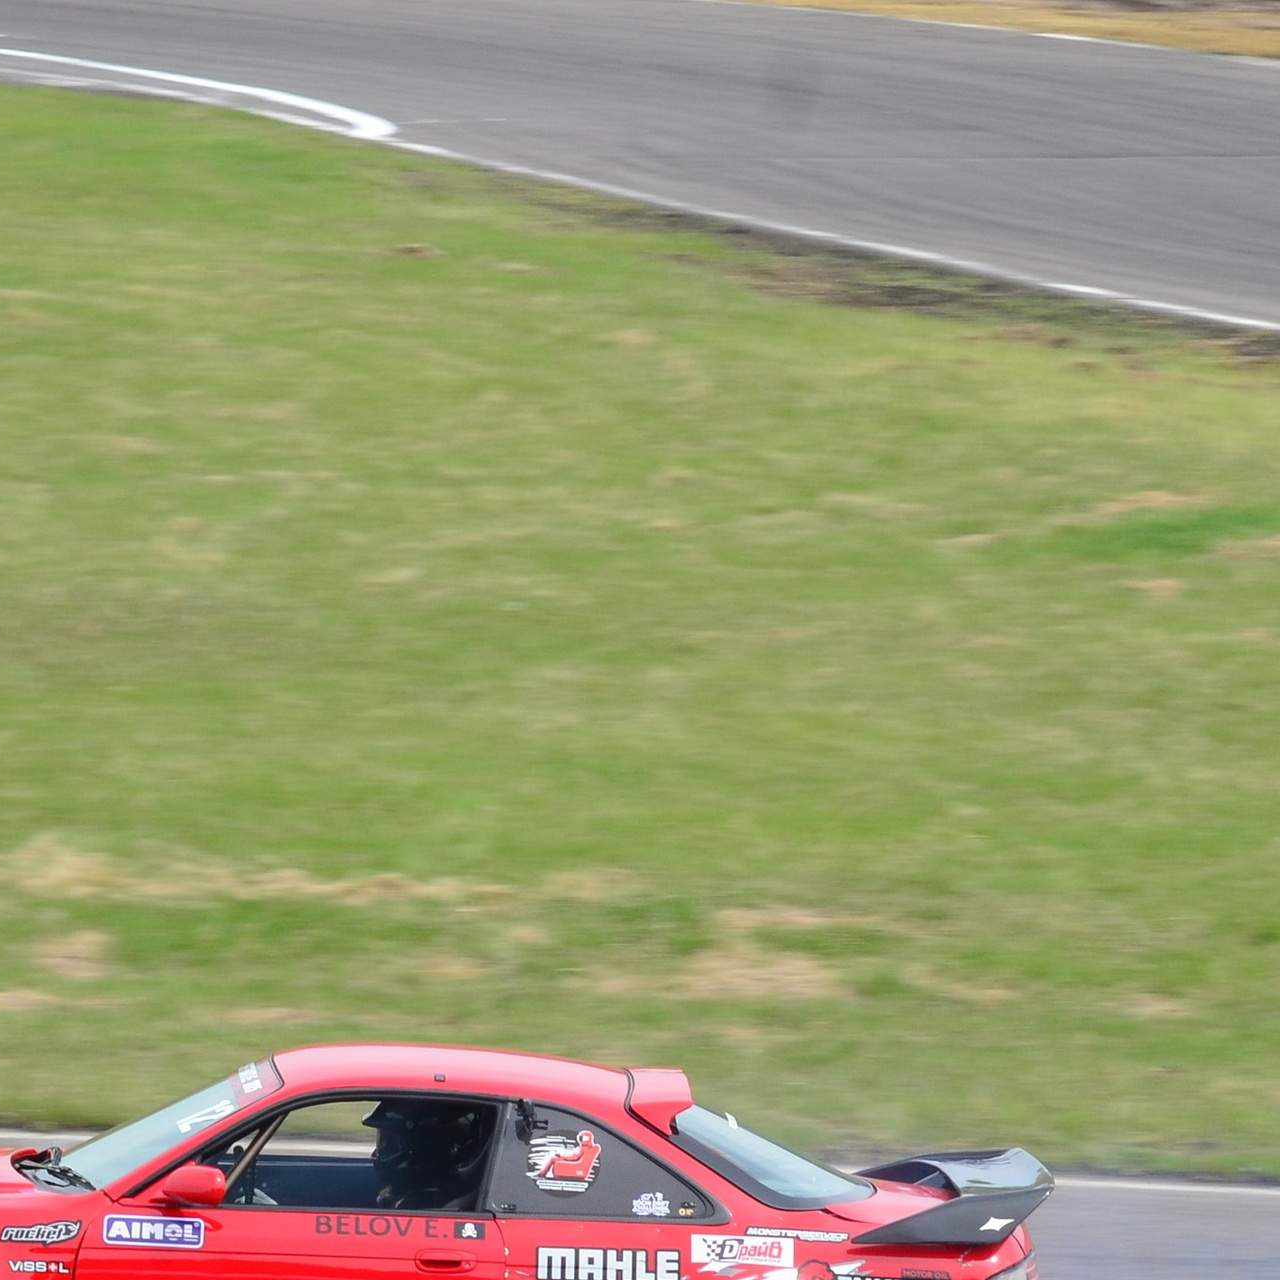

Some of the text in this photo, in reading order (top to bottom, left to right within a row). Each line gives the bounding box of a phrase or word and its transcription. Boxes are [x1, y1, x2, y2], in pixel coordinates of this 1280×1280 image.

[108, 1220, 199, 1243] AIMOL
[315, 1215, 448, 1238] BELOV E.
